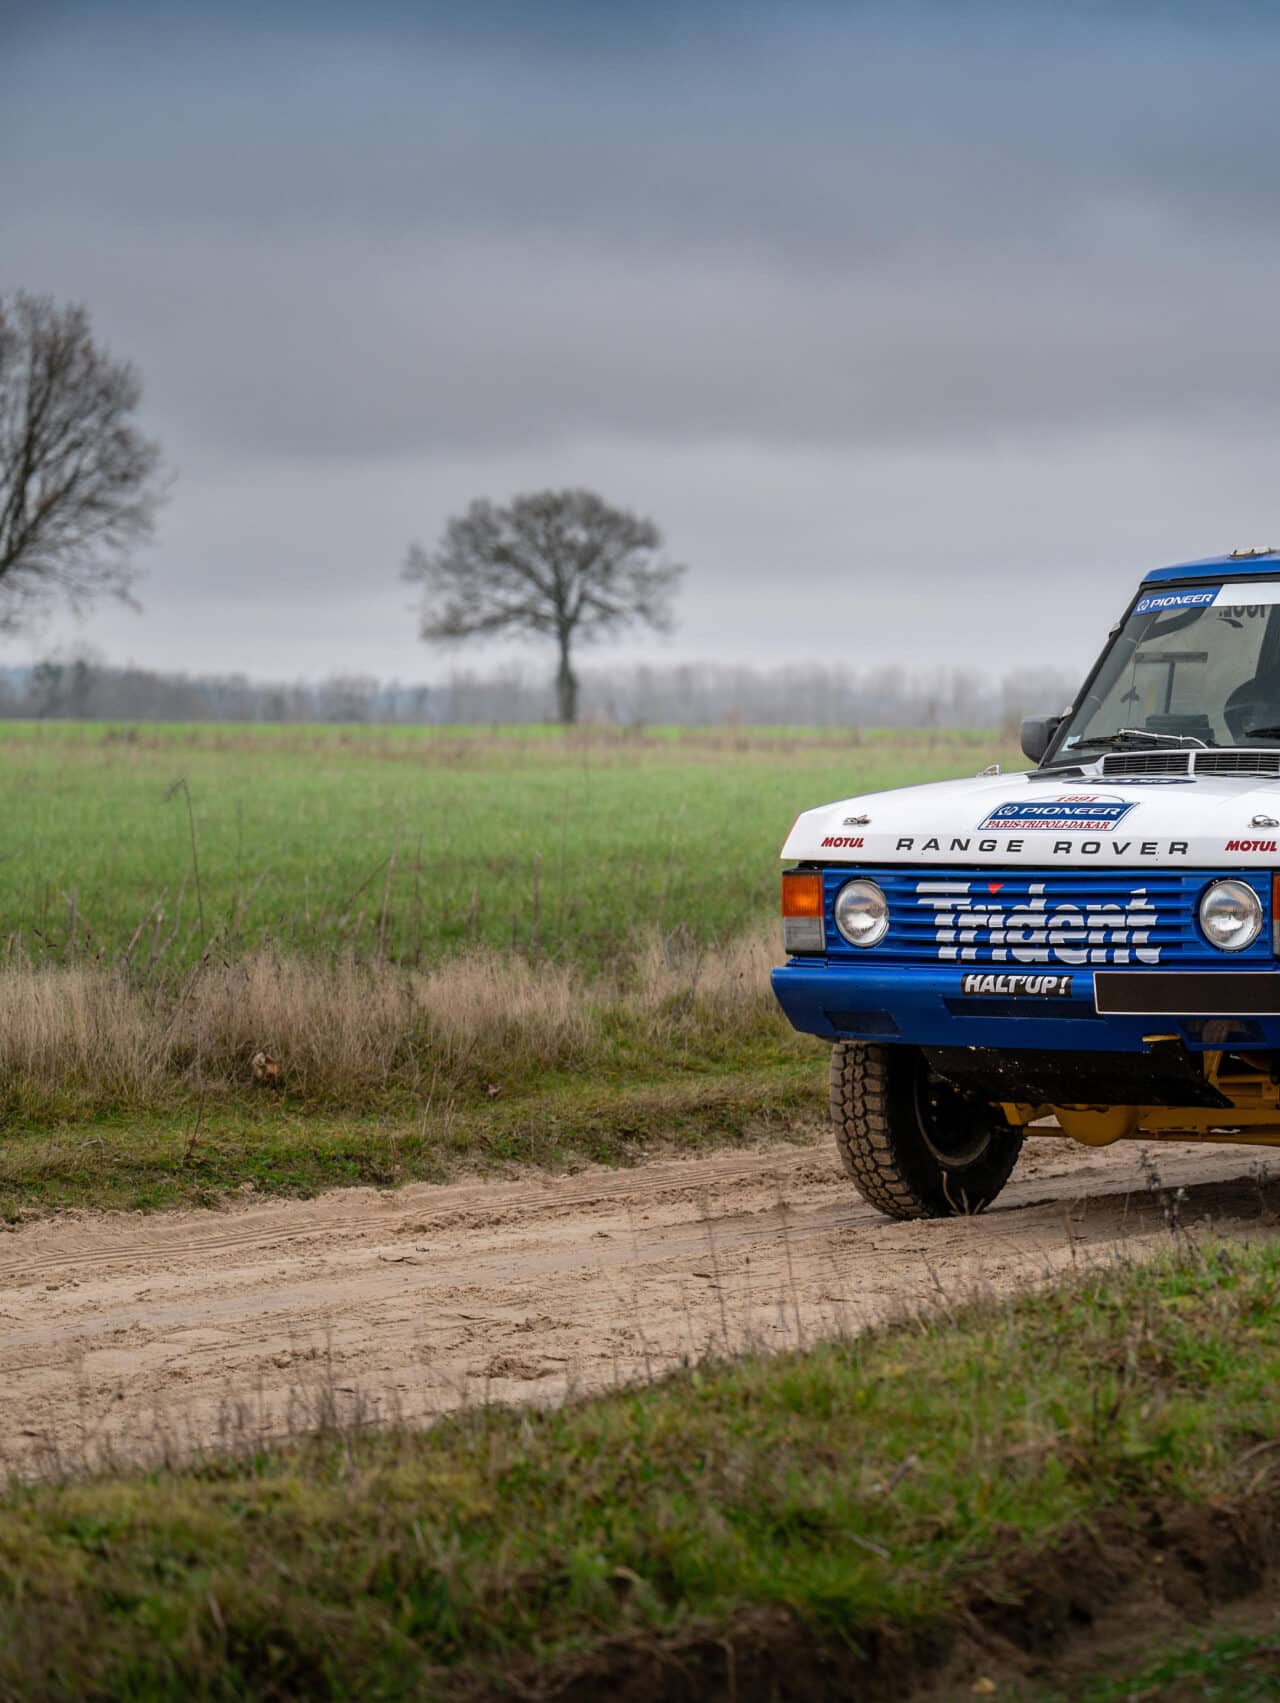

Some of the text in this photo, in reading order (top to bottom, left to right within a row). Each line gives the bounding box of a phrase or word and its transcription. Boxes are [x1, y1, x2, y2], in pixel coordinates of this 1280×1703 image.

[1150, 593, 1214, 609] PIONEER
[1019, 807, 1123, 816] PIONEER
[821, 837, 864, 848] MOTUL
[896, 838, 1190, 855] RANGE ROVER
[1225, 840, 1278, 852] MOTUL
[916, 882, 1162, 964] Trident
